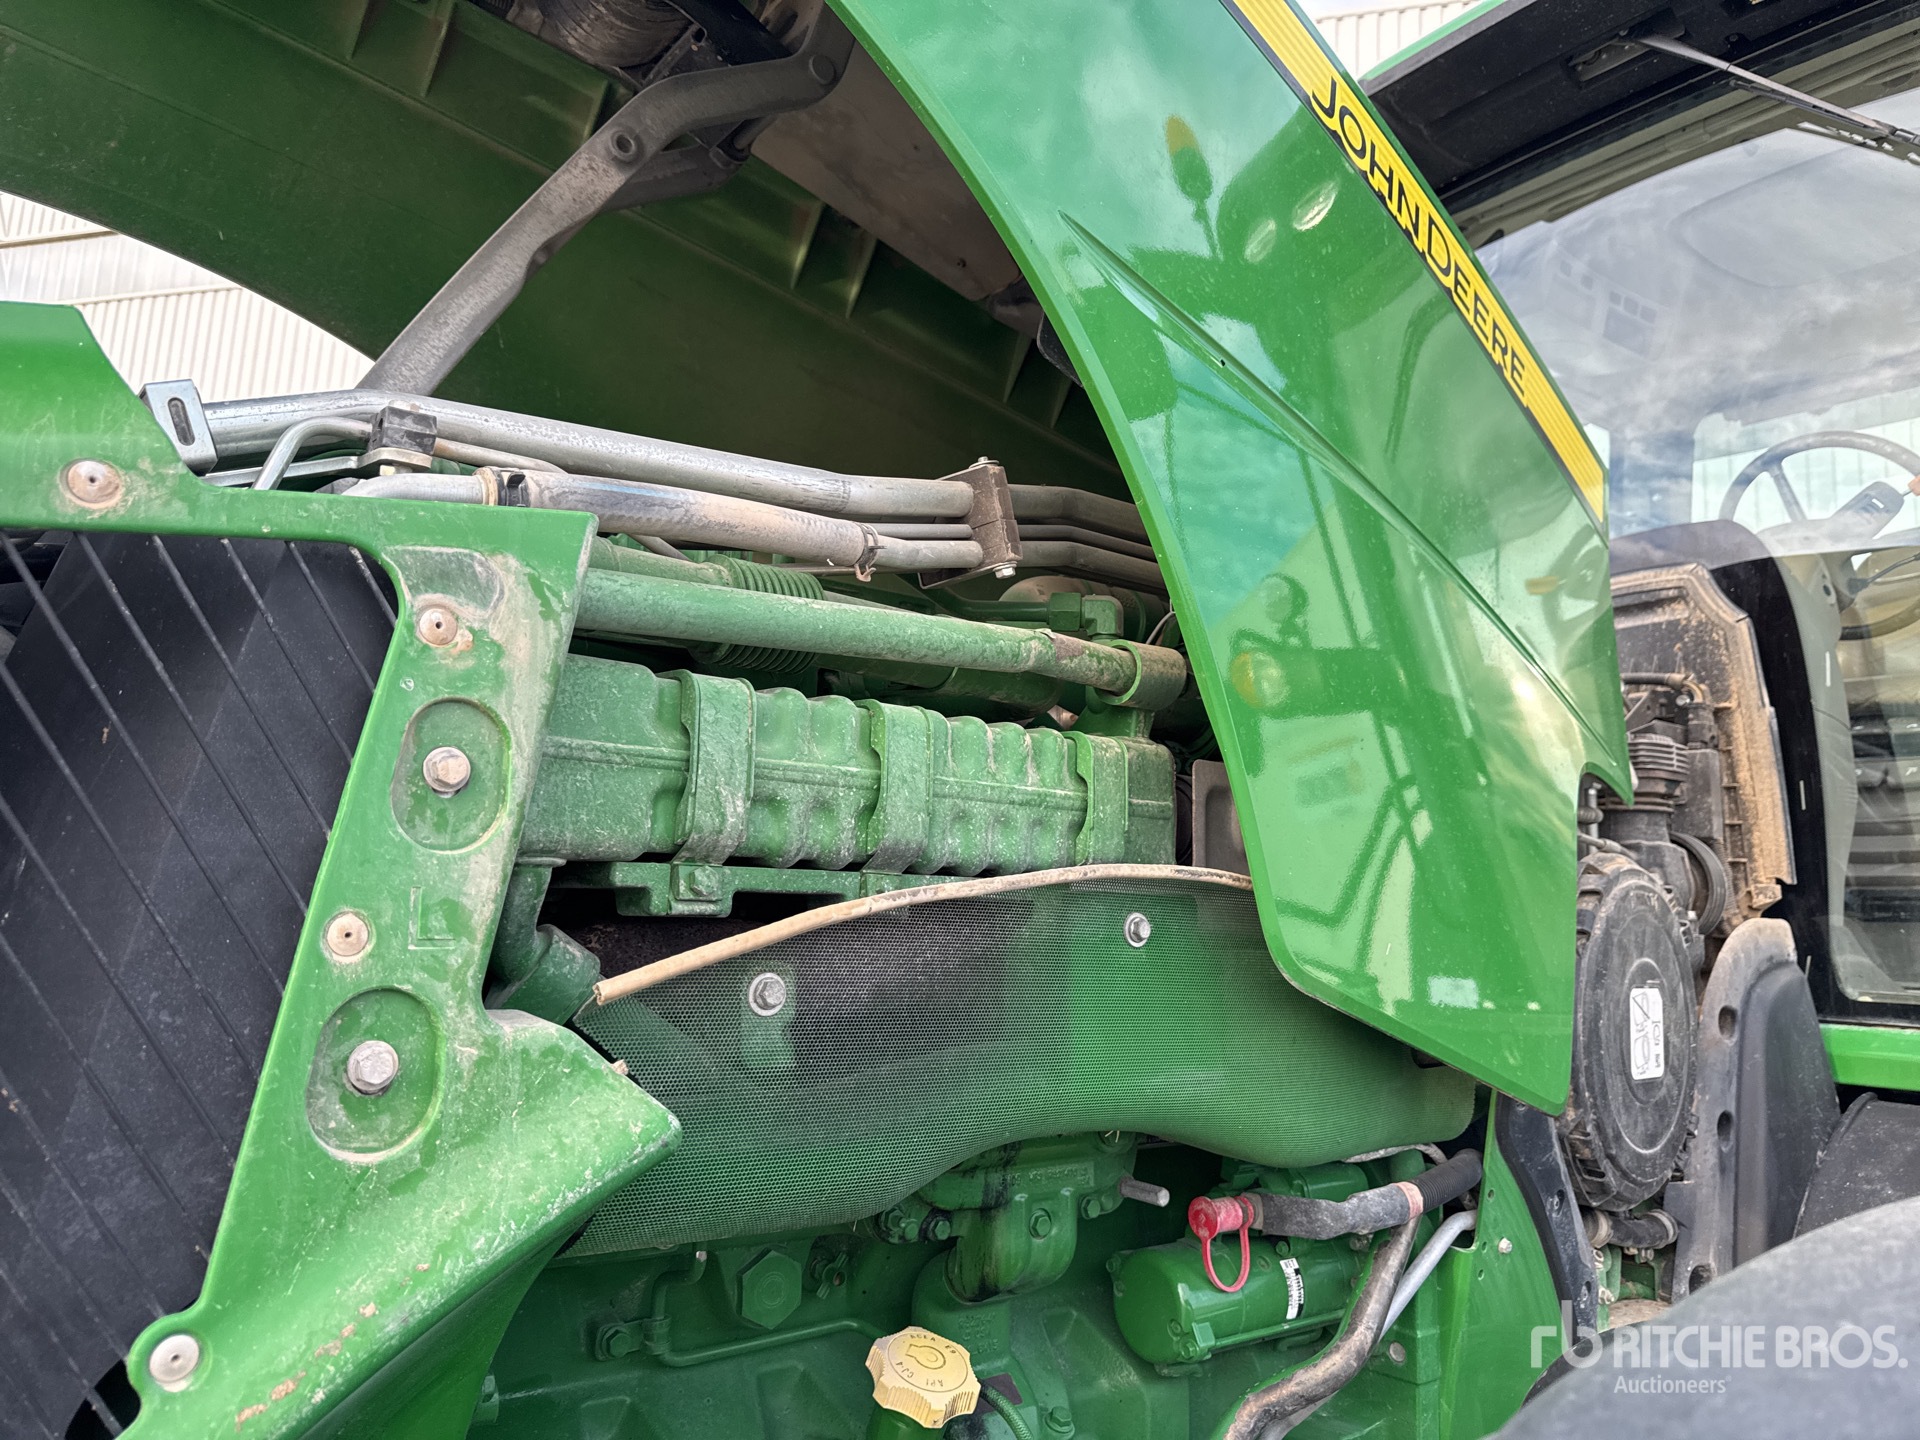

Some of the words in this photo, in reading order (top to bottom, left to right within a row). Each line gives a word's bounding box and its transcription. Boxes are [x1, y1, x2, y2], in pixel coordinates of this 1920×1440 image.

[1312, 76, 1420, 242] JOHN
[1427, 217, 1525, 397] DEERE
[925, 1378, 944, 1388] API
